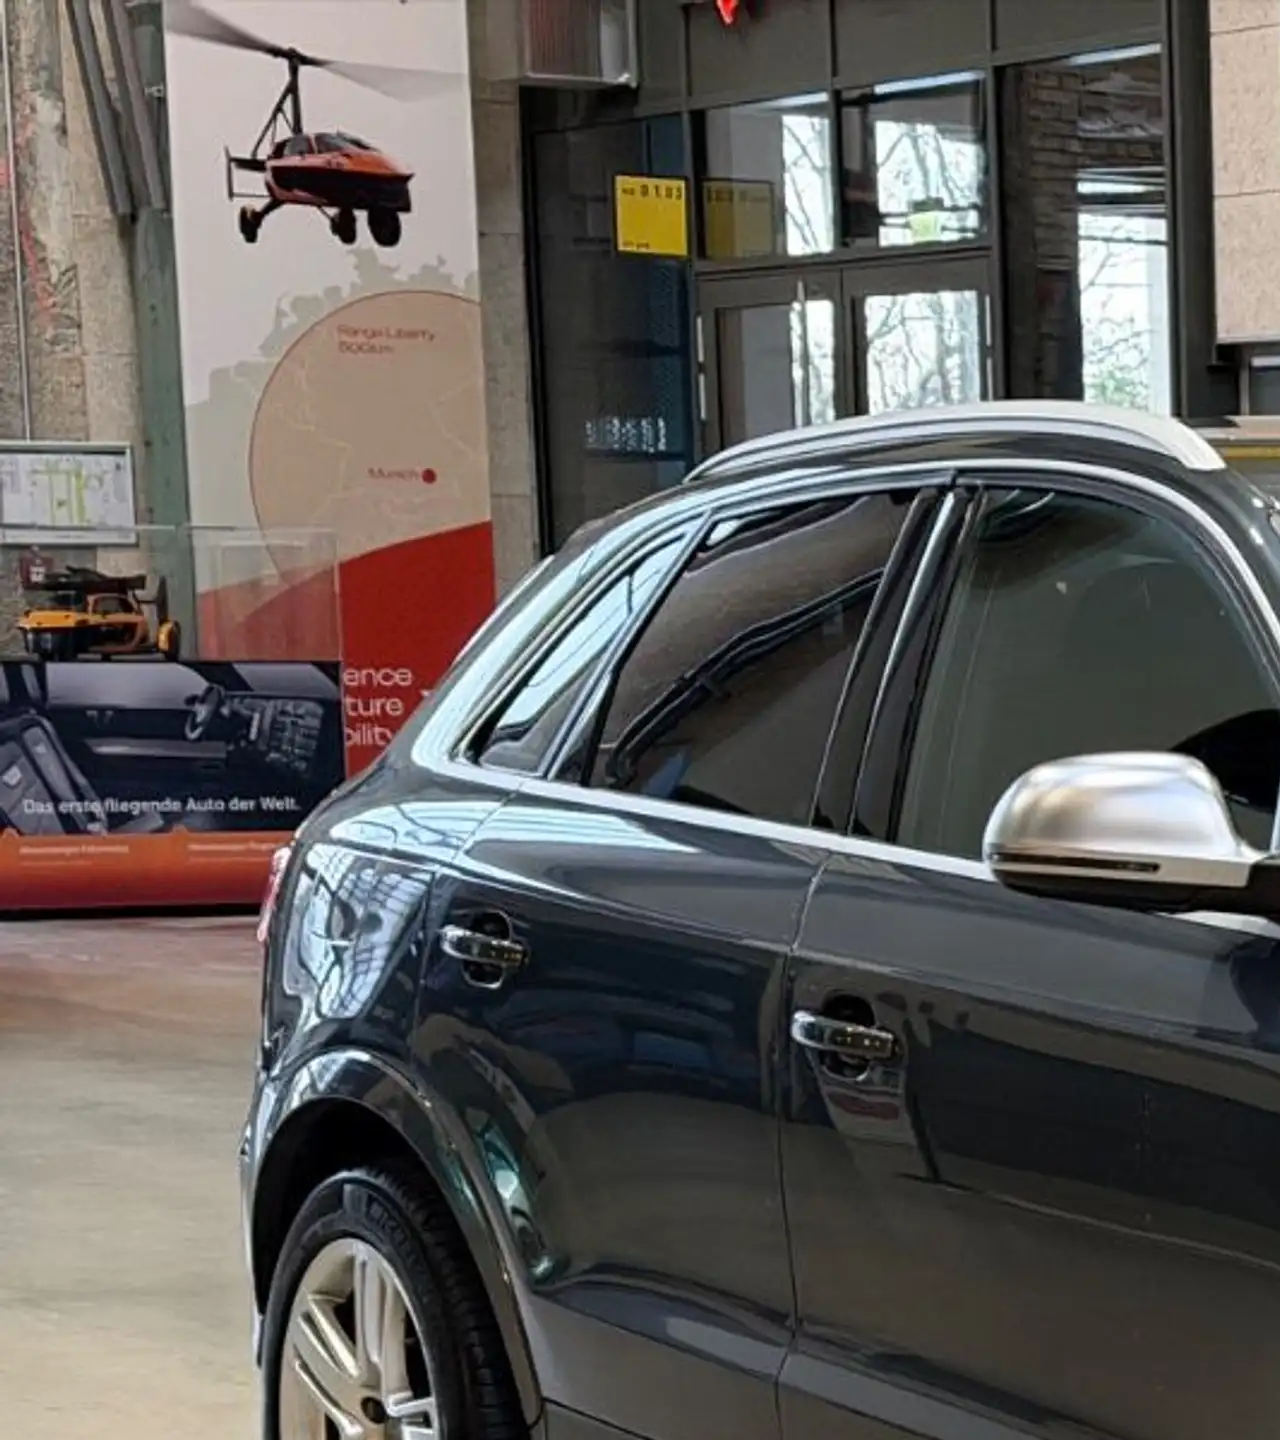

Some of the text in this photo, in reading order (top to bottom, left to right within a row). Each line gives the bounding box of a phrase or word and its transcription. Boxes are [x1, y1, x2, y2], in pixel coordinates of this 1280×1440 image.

[24, 799, 54, 814] Das
[59, 799, 100, 814] erste
[104, 797, 181, 815] fliegende
[186, 798, 224, 812] Auto
[229, 797, 255, 811] der
